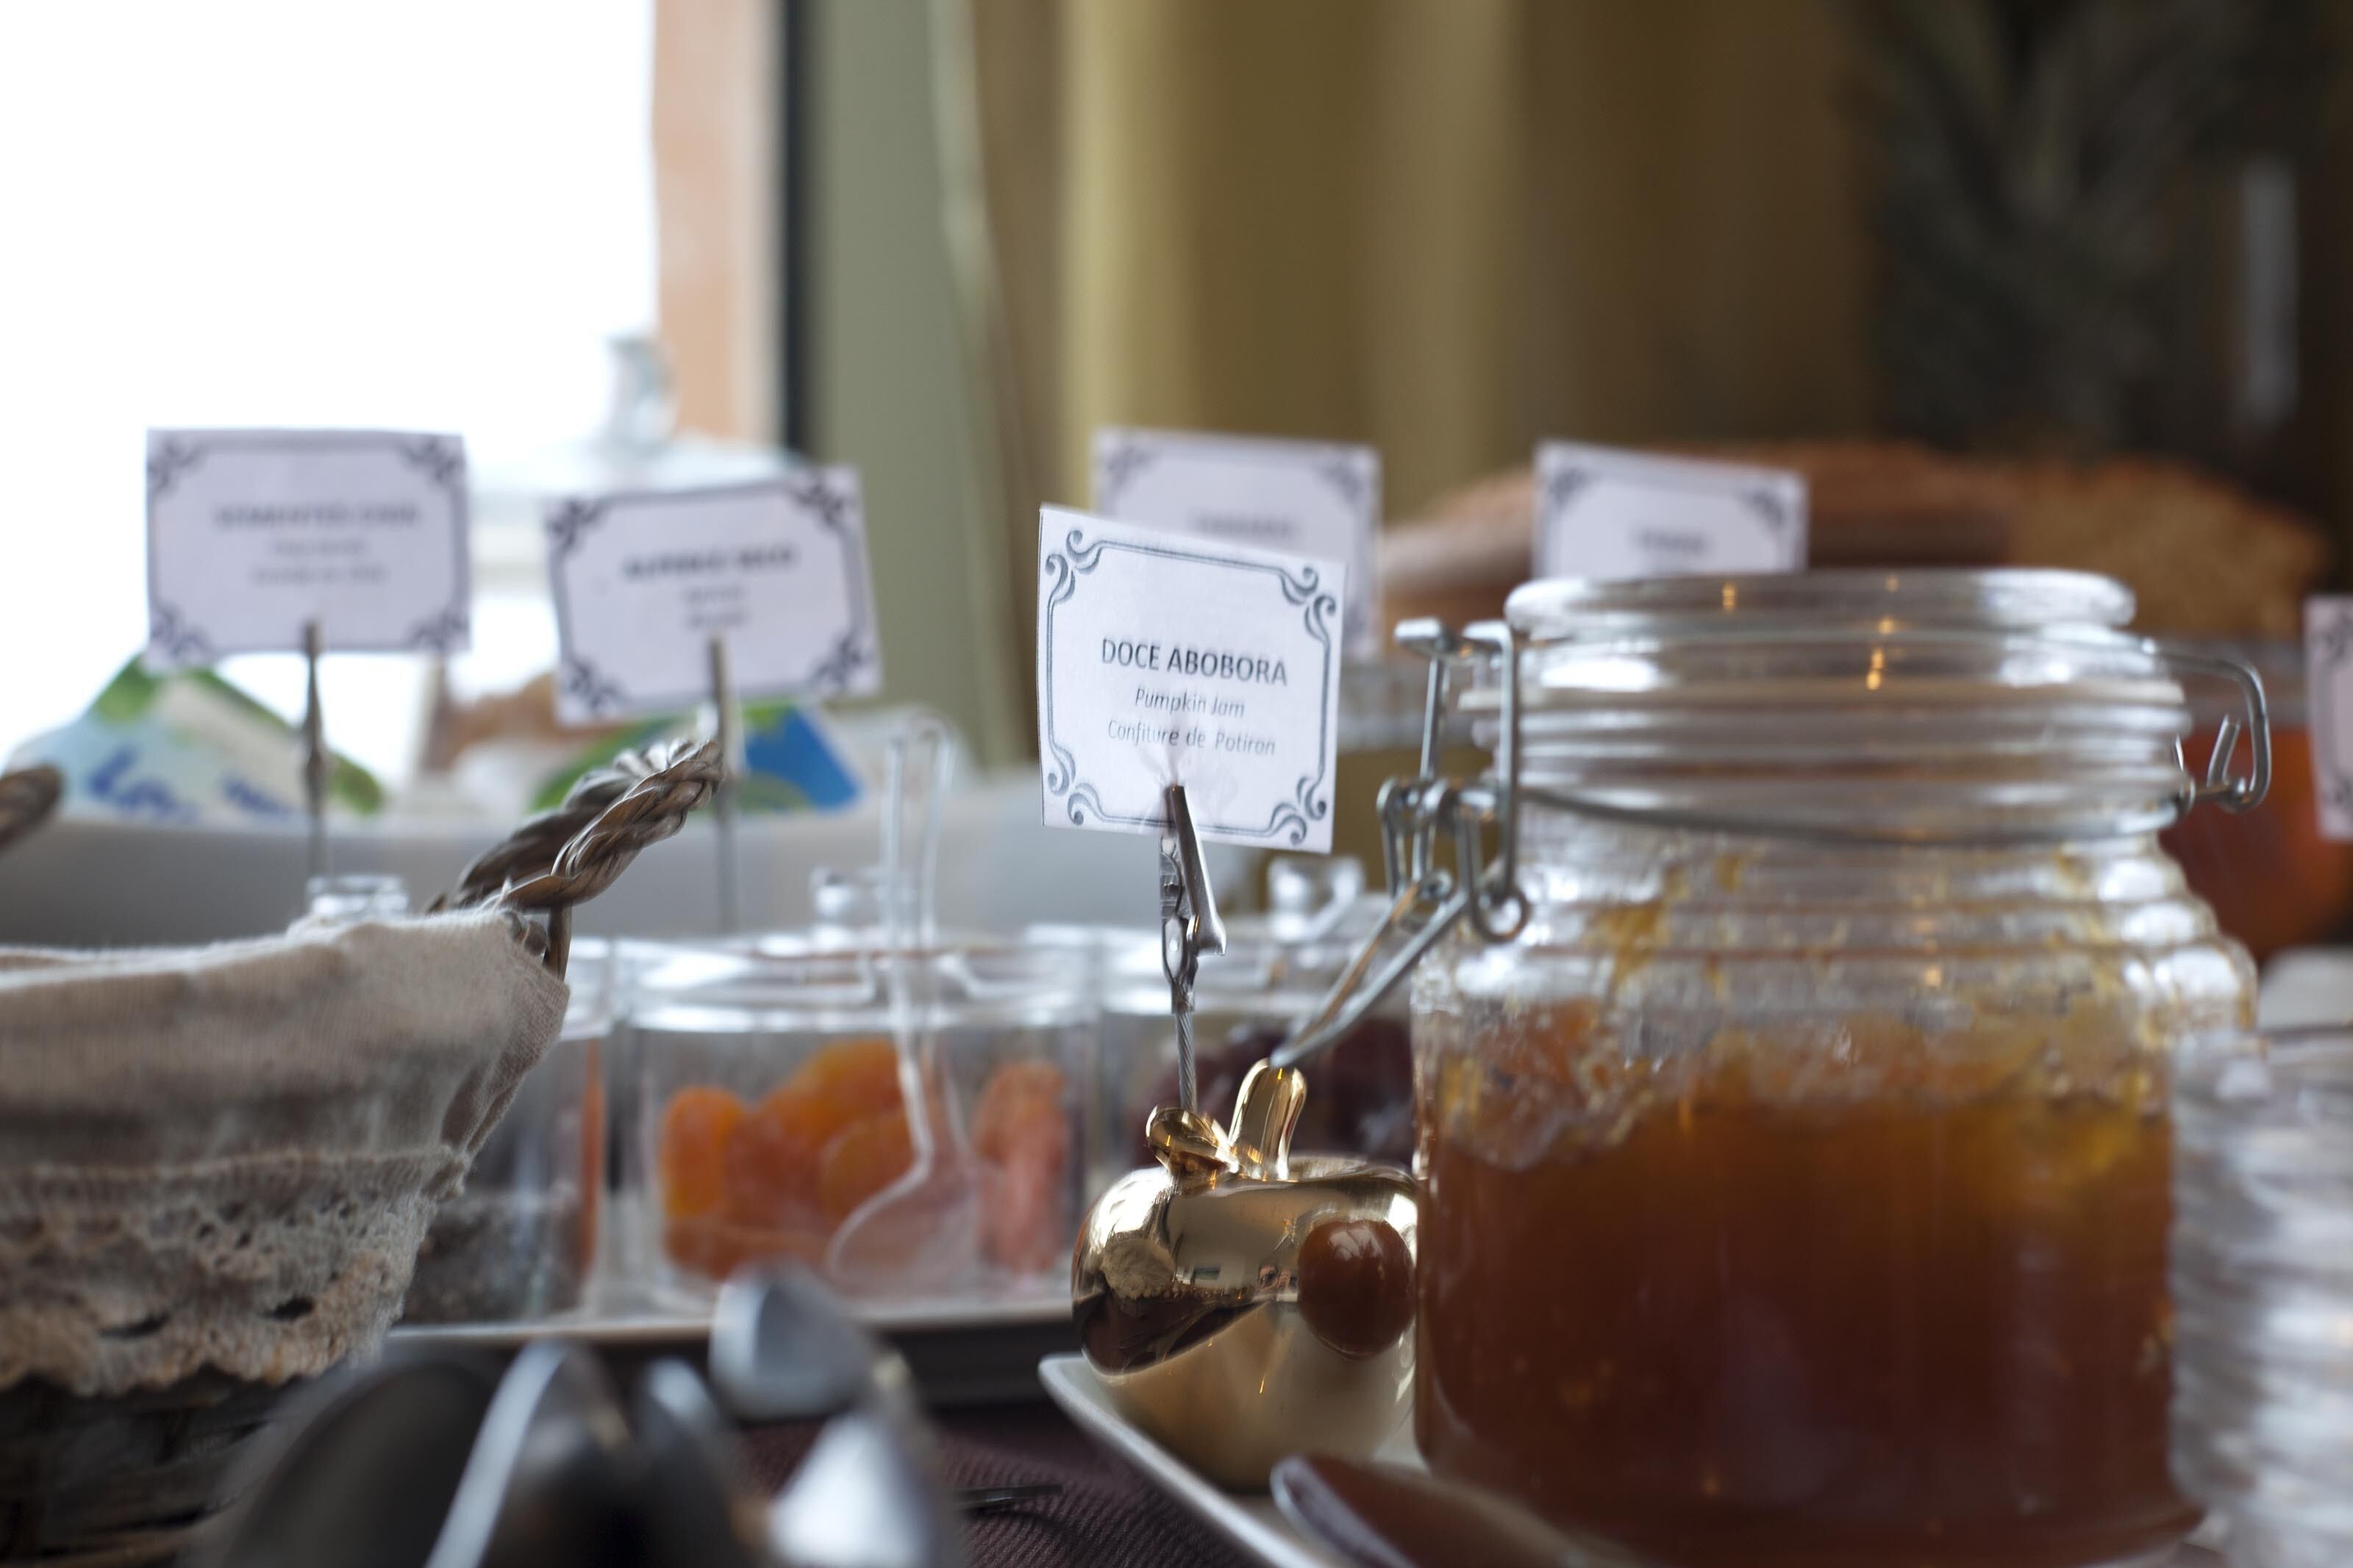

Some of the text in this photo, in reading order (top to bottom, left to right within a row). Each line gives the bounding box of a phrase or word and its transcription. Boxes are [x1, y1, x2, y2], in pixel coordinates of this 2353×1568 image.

[1102, 638, 1288, 685] DOCE ABOBORA
[1135, 687, 1245, 718] Pumpkin Jam
[1107, 720, 1276, 756] Confiture de Potiron
